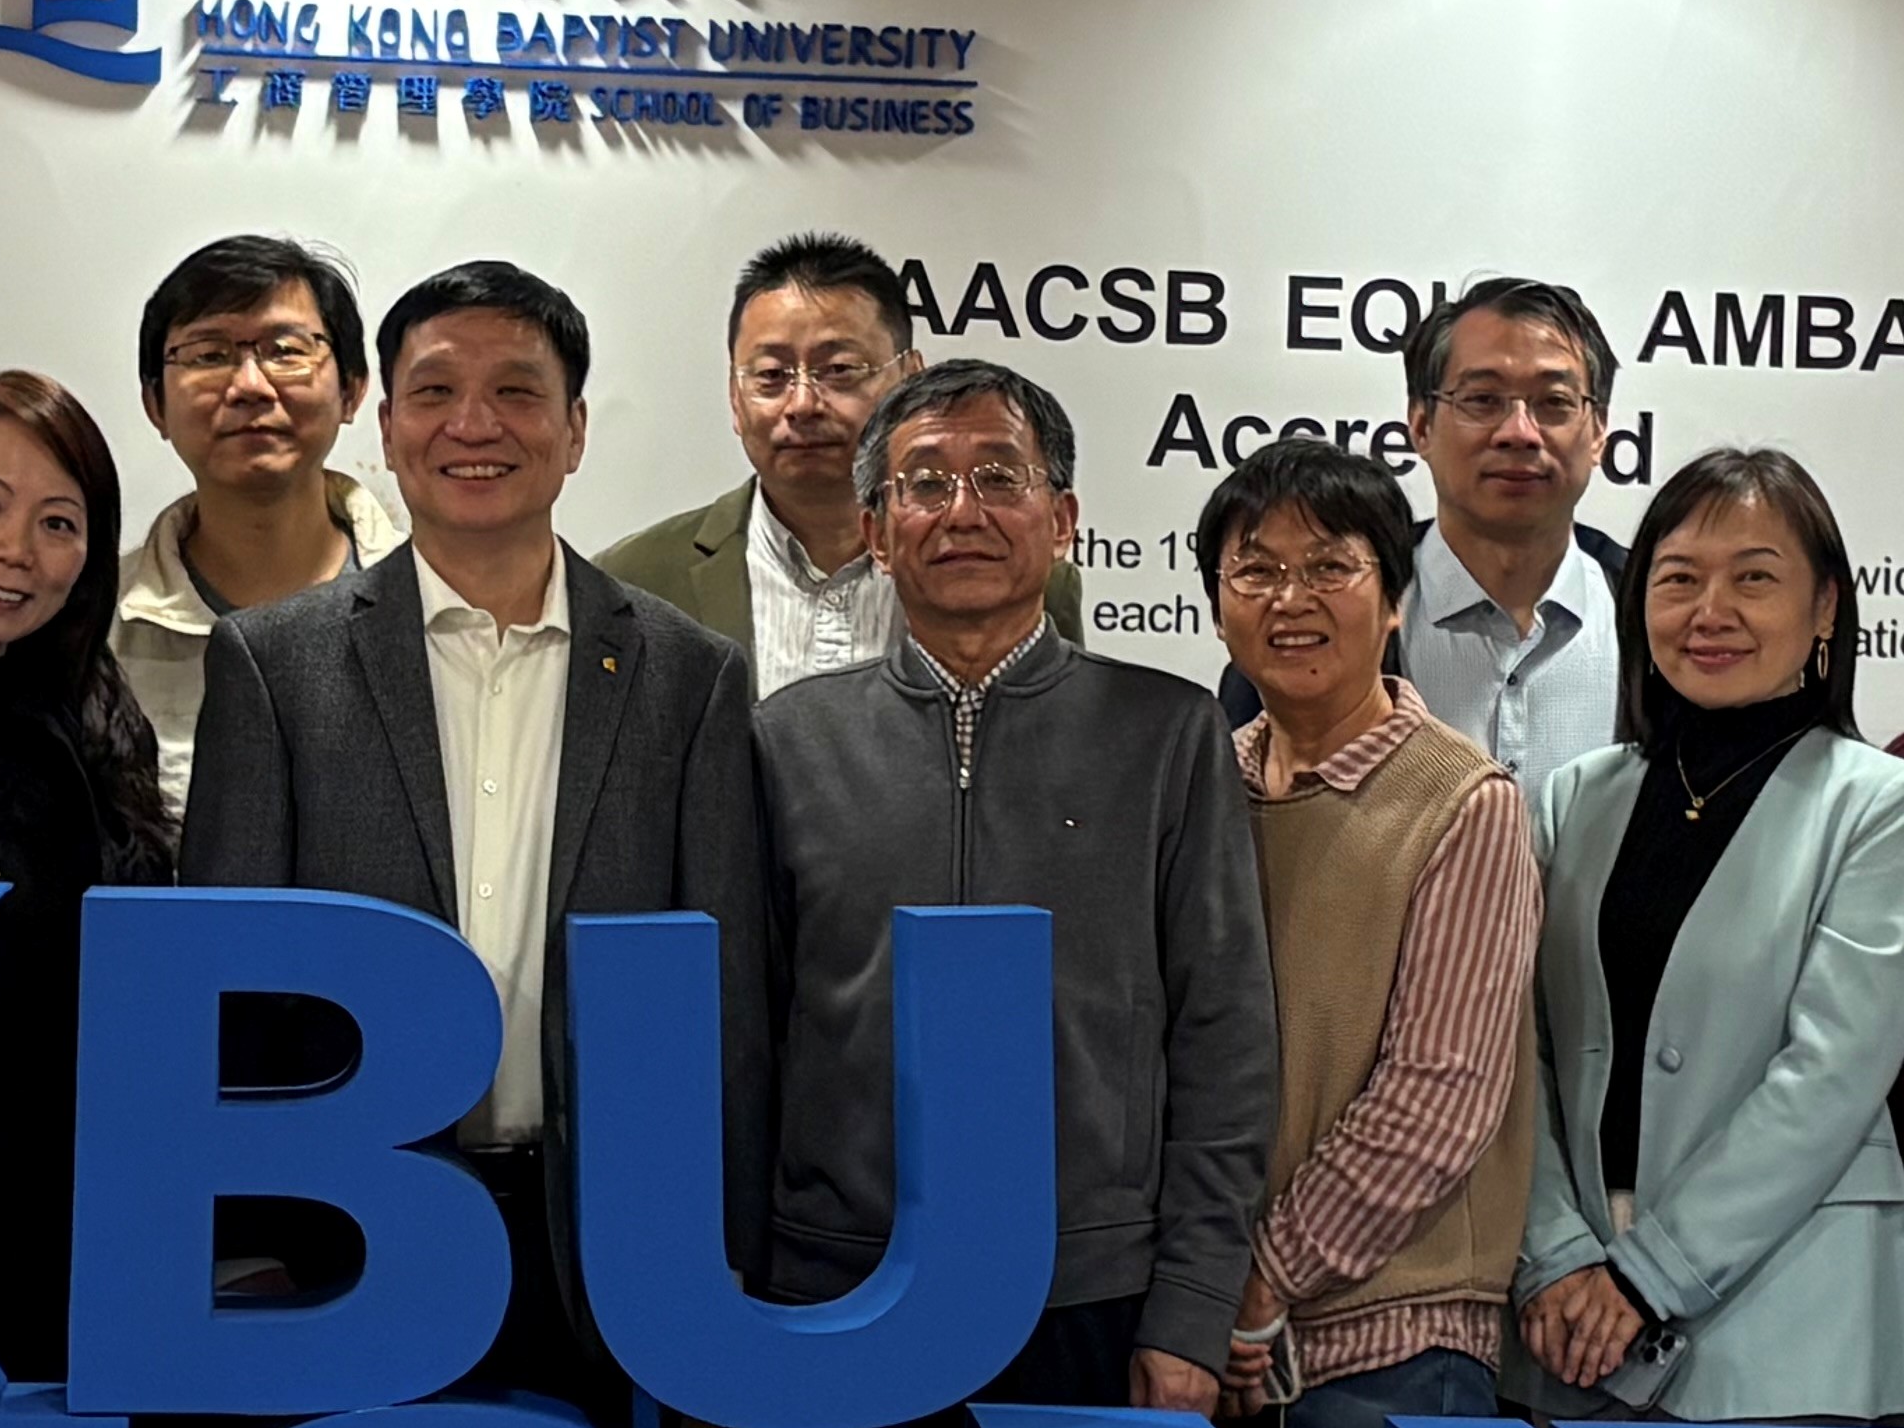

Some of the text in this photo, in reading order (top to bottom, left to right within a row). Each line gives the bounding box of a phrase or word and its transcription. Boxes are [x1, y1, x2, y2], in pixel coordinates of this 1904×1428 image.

[348, 3, 469, 57] KONG
[498, 11, 687, 59] BAPTIST
[709, 18, 976, 70] UNIVERSITY
[196, 68, 976, 136] 工商管理學院 SCHOOL OF BUSINESS
[899, 259, 1228, 346] AACSB
[1072, 528, 1142, 569] the
[1093, 594, 1200, 635] each
